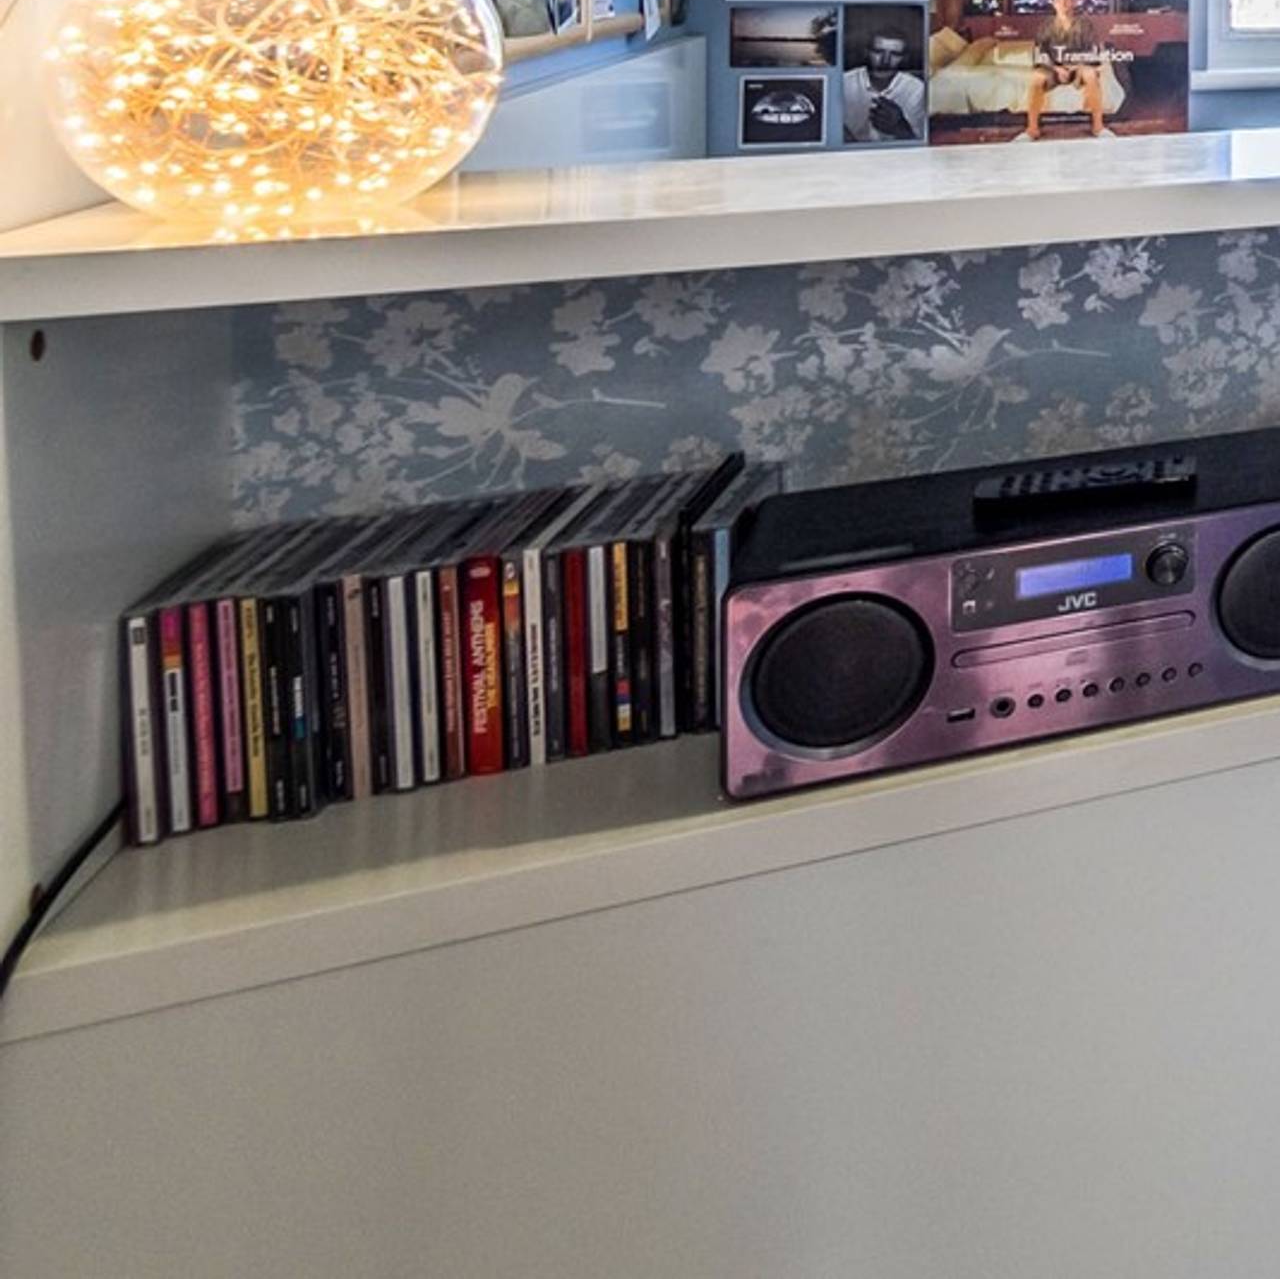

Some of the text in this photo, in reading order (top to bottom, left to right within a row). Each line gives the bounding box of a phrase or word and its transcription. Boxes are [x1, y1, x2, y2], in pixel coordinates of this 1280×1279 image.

[1058, 592, 1097, 612] JVC
[469, 600, 487, 734] FESTIVAL ANTHEMS
